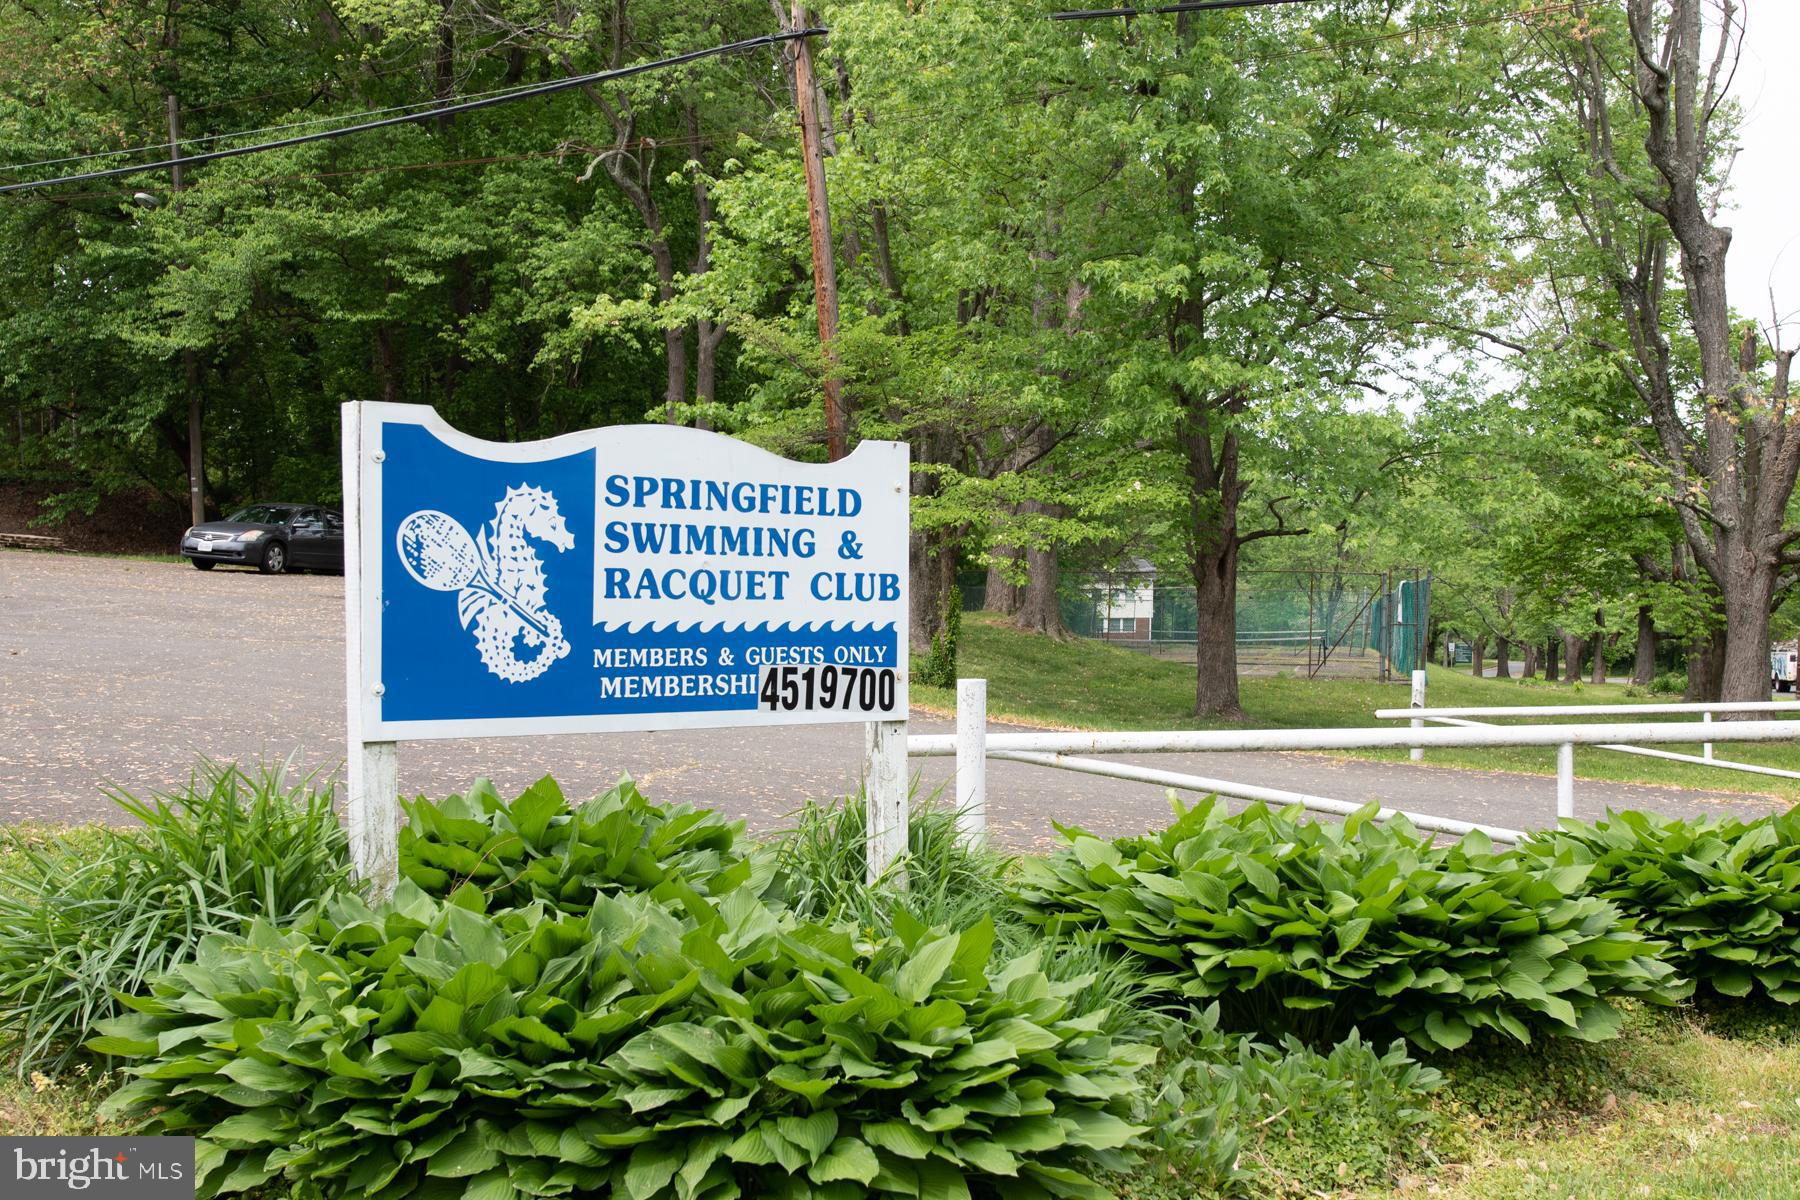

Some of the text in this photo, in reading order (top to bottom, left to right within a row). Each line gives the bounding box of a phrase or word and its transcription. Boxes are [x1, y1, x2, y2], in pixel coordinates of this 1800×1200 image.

[604, 474, 862, 517] SPRINGFIELD
[604, 521, 863, 560] SWIMMING &
[603, 567, 901, 605] RACQUET CLUB
[592, 645, 887, 668] MEMBERS & GUESTS ONLY
[600, 674, 757, 699] MEMBERSHI
[760, 664, 896, 712] 4519700
